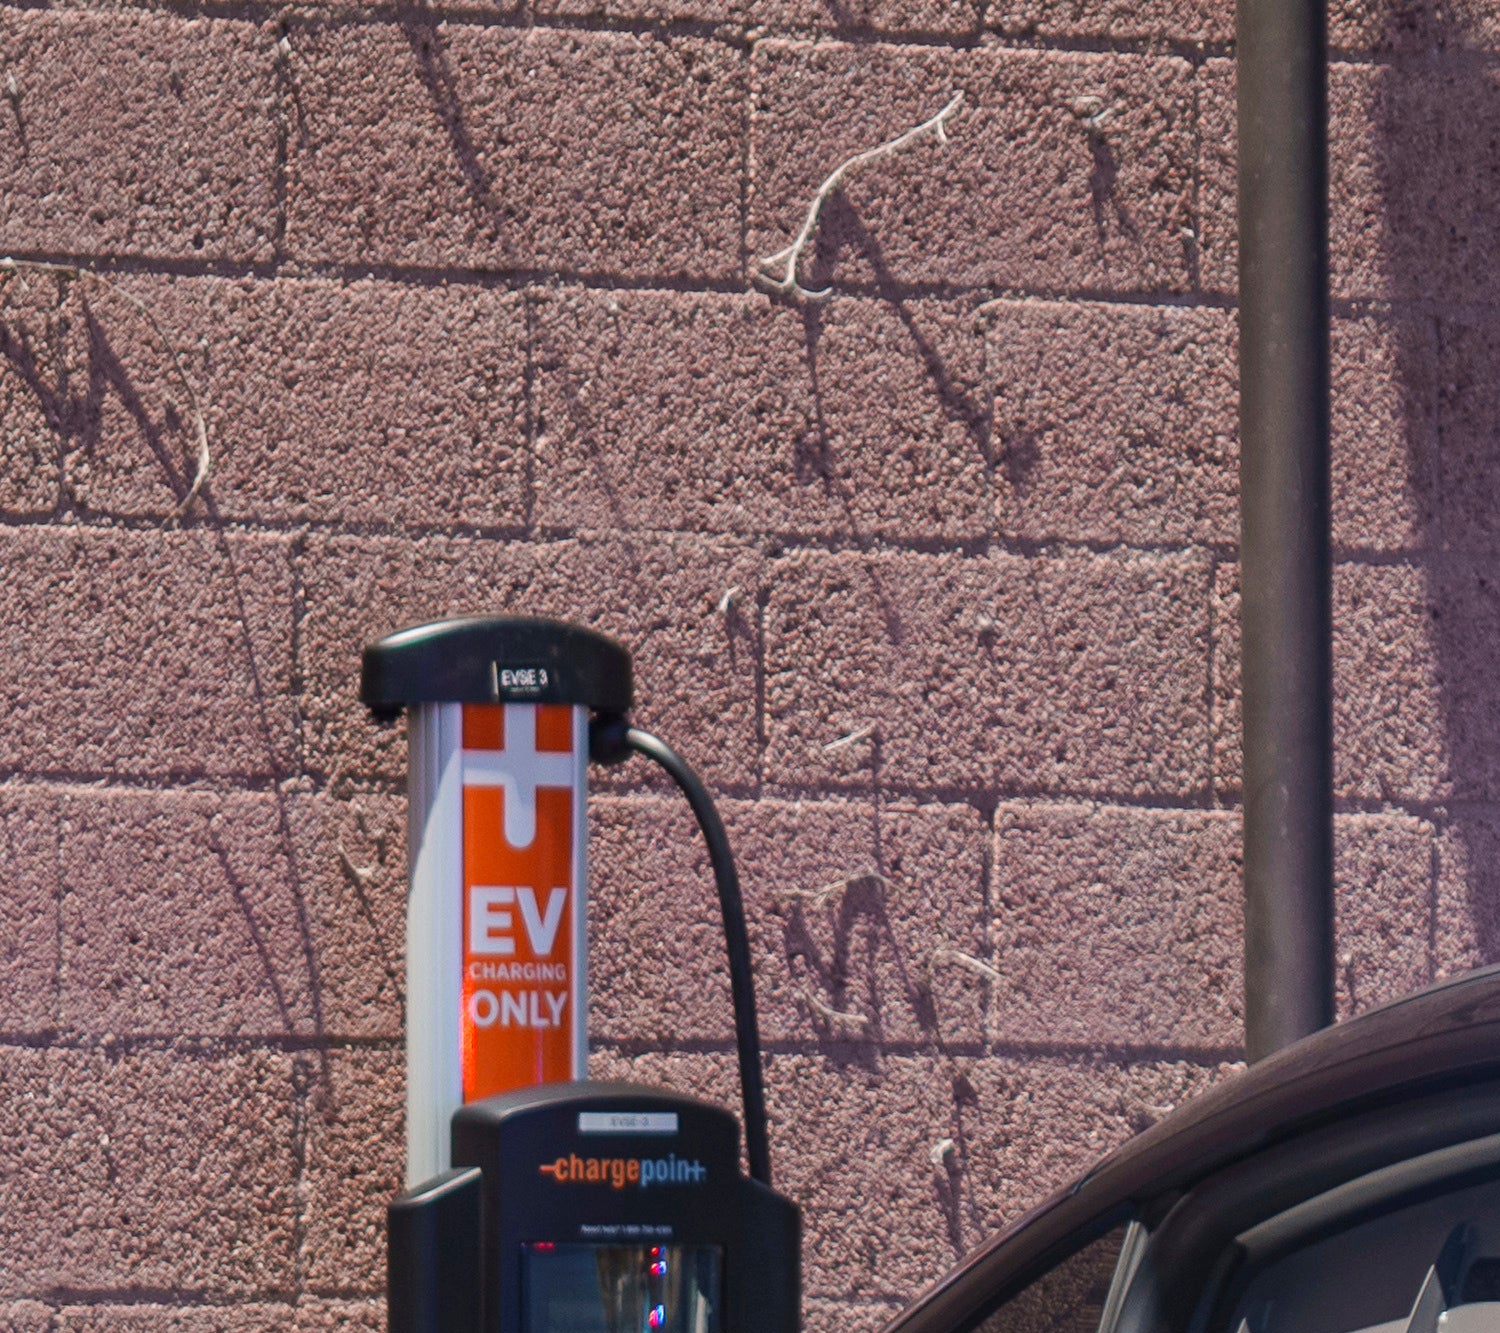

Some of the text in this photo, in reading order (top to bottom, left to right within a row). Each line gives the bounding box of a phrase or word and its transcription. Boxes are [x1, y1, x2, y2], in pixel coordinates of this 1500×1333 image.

[501, 668, 536, 686] EVSE
[469, 885, 568, 956] EV
[469, 961, 567, 982] CHARGING
[469, 988, 568, 1028] ONLY
